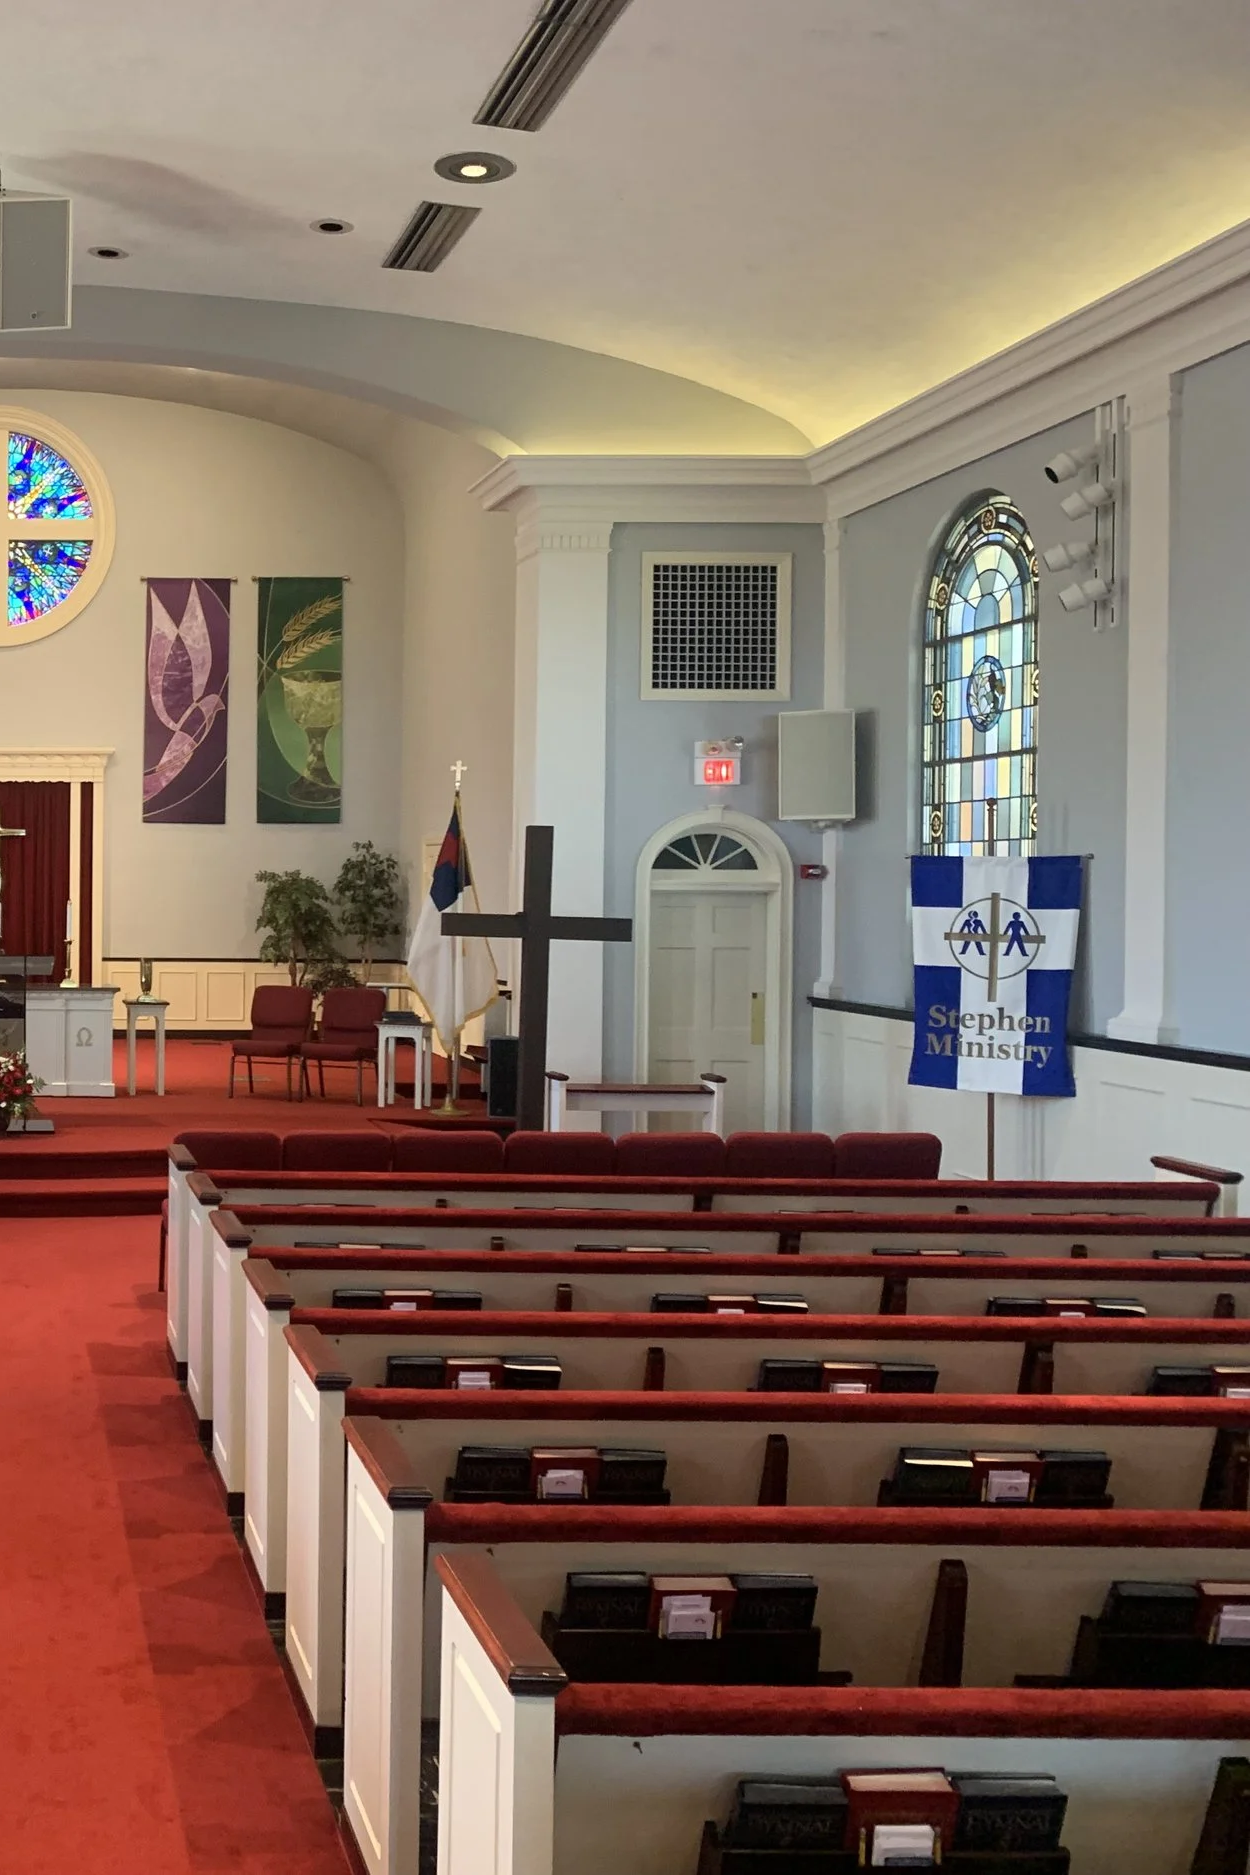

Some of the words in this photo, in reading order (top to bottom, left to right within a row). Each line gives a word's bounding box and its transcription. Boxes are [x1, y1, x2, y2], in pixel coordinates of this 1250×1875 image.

[928, 1004, 1051, 1036] Stephen
[75, 1026, 93, 1047] Ω
[924, 1032, 1053, 1068] Ministry
